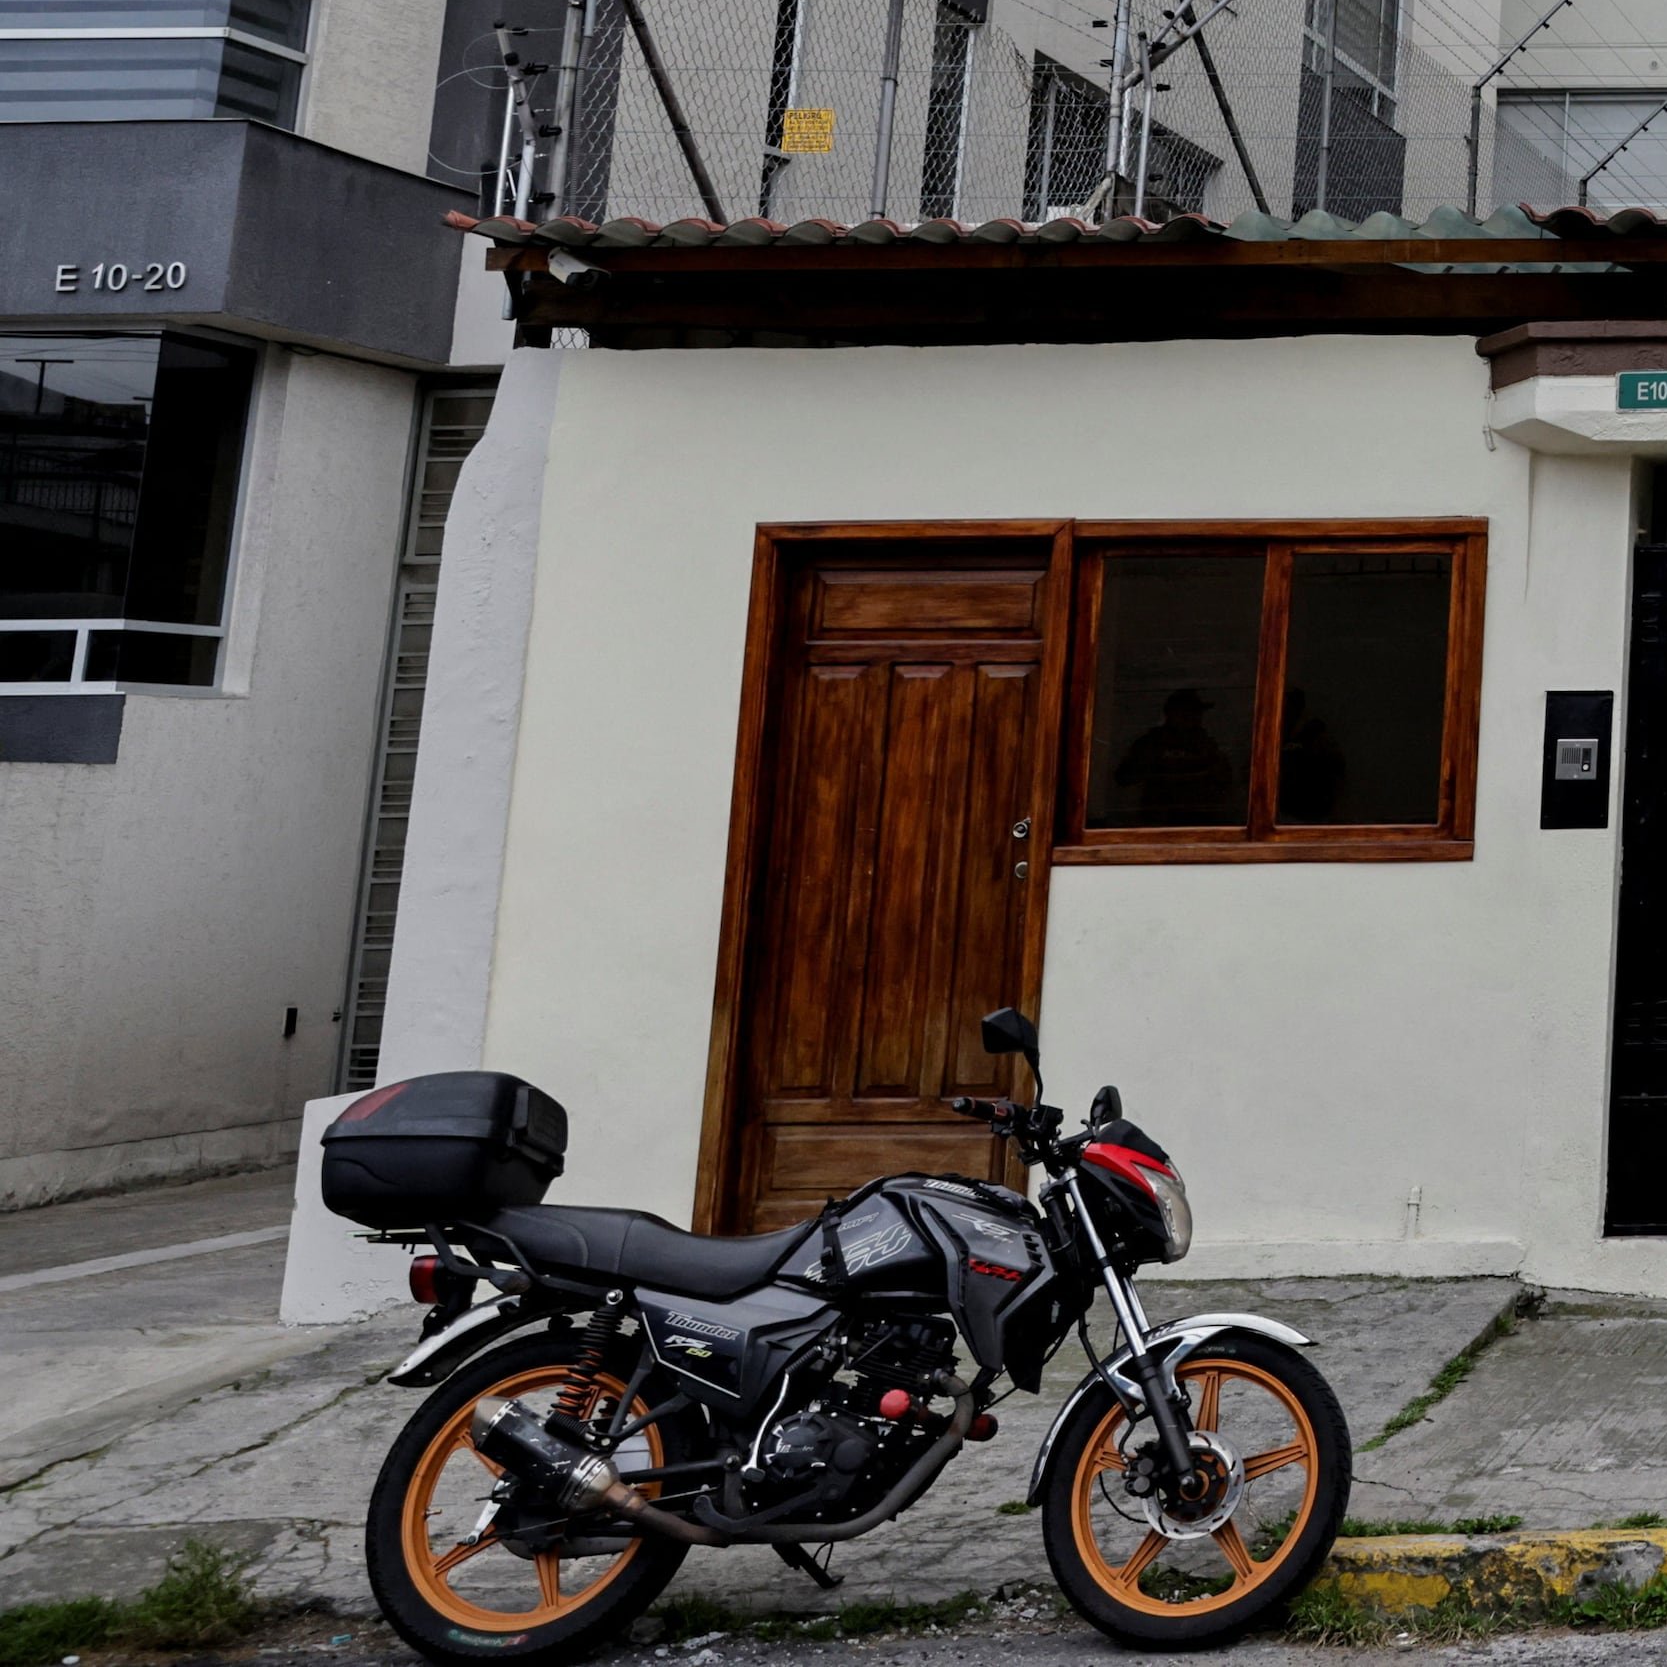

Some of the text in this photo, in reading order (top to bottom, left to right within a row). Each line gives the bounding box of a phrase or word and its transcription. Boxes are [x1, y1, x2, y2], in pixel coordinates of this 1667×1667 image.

[55, 261, 186, 291] E 10-20
[665, 1311, 740, 1340] Thunder
[664, 1334, 712, 1348] RS
